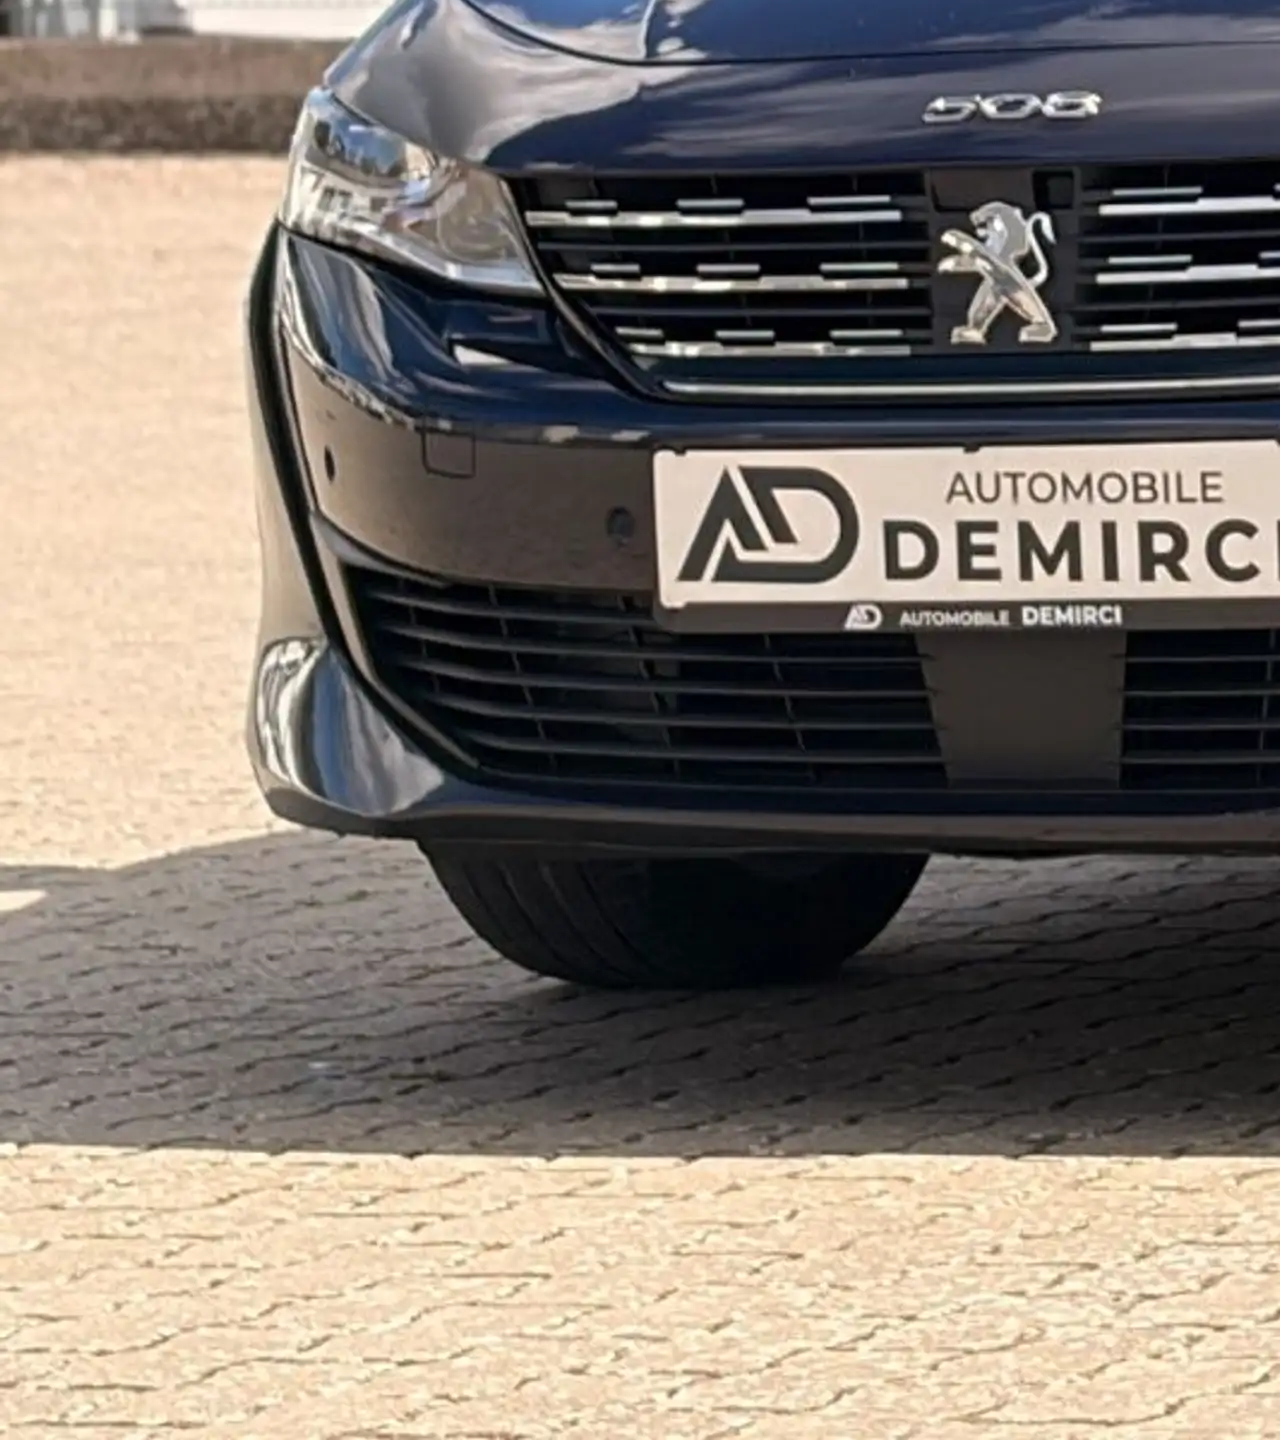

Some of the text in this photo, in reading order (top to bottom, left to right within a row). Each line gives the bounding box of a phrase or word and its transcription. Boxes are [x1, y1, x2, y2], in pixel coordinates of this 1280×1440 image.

[922, 90, 1102, 124] 508
[944, 471, 1225, 505] AUTOMOBILE
[899, 609, 1011, 628] AUTOMOBILE
[1020, 604, 1123, 627] DEMIRCI
